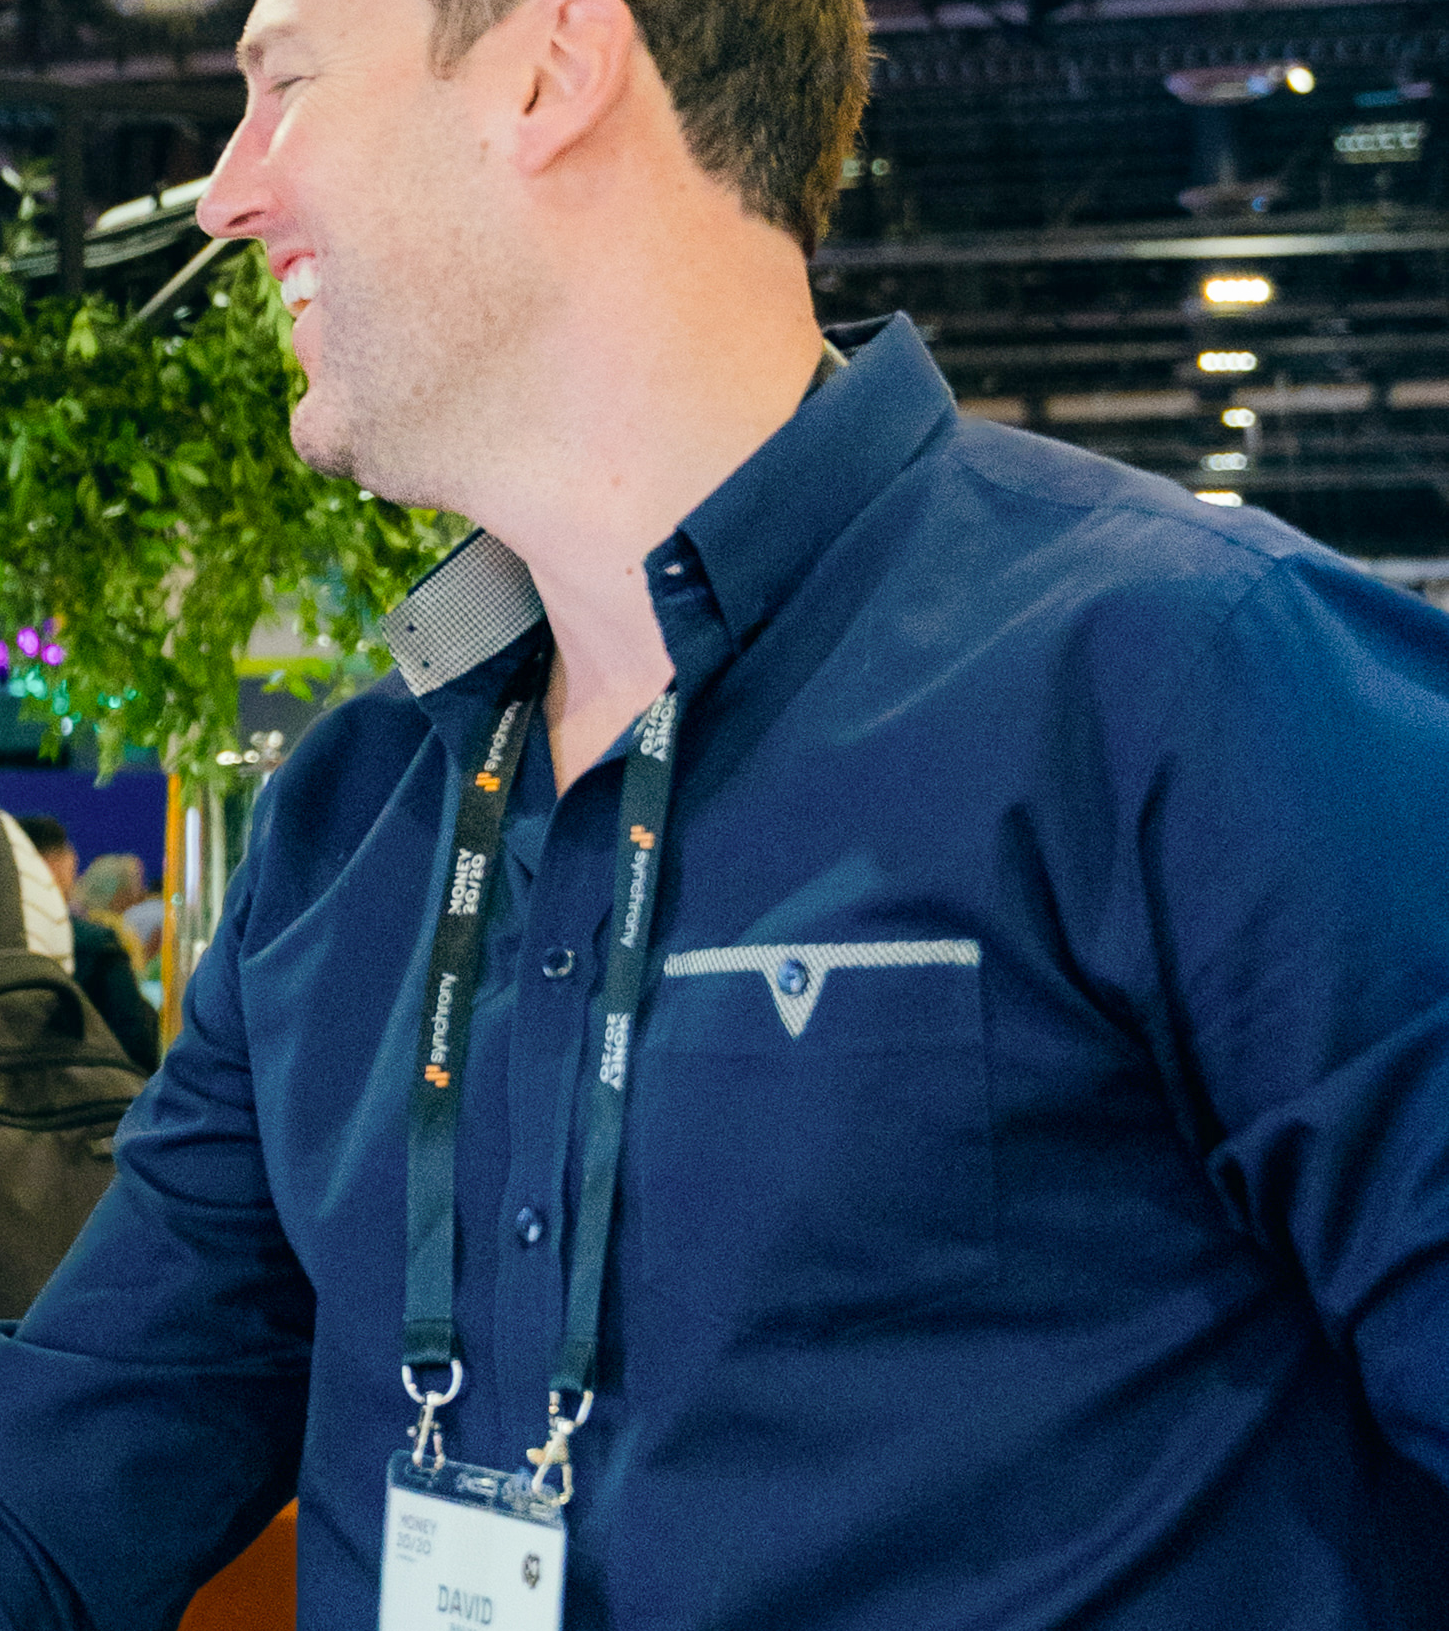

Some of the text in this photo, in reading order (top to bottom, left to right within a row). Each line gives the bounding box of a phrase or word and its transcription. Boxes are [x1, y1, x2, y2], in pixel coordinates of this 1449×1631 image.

[448, 848, 473, 916] MONEY
[461, 853, 487, 915] 20/20
[620, 851, 650, 949] synchrony
[429, 972, 457, 1064] synchrony
[599, 1013, 619, 1083] 20/20
[609, 1013, 631, 1091] MONEY
[437, 1584, 493, 1626] DAVID
